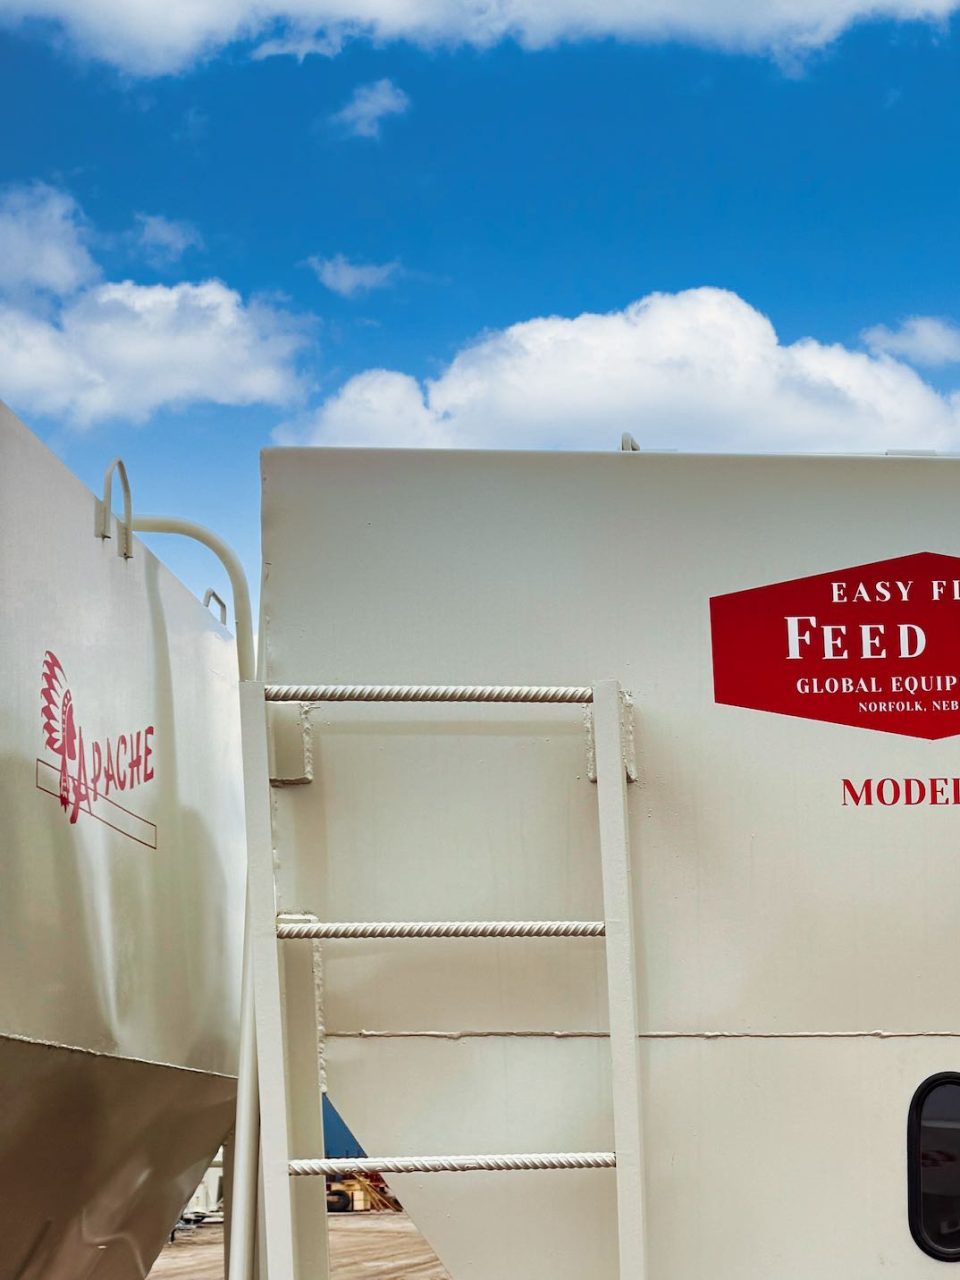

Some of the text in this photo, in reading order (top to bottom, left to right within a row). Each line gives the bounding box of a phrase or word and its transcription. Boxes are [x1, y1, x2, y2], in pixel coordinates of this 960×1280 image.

[830, 581, 914, 603] EASY
[784, 615, 927, 660] FEED
[796, 676, 883, 694] GLOBAL
[69, 725, 155, 825] APACHE
